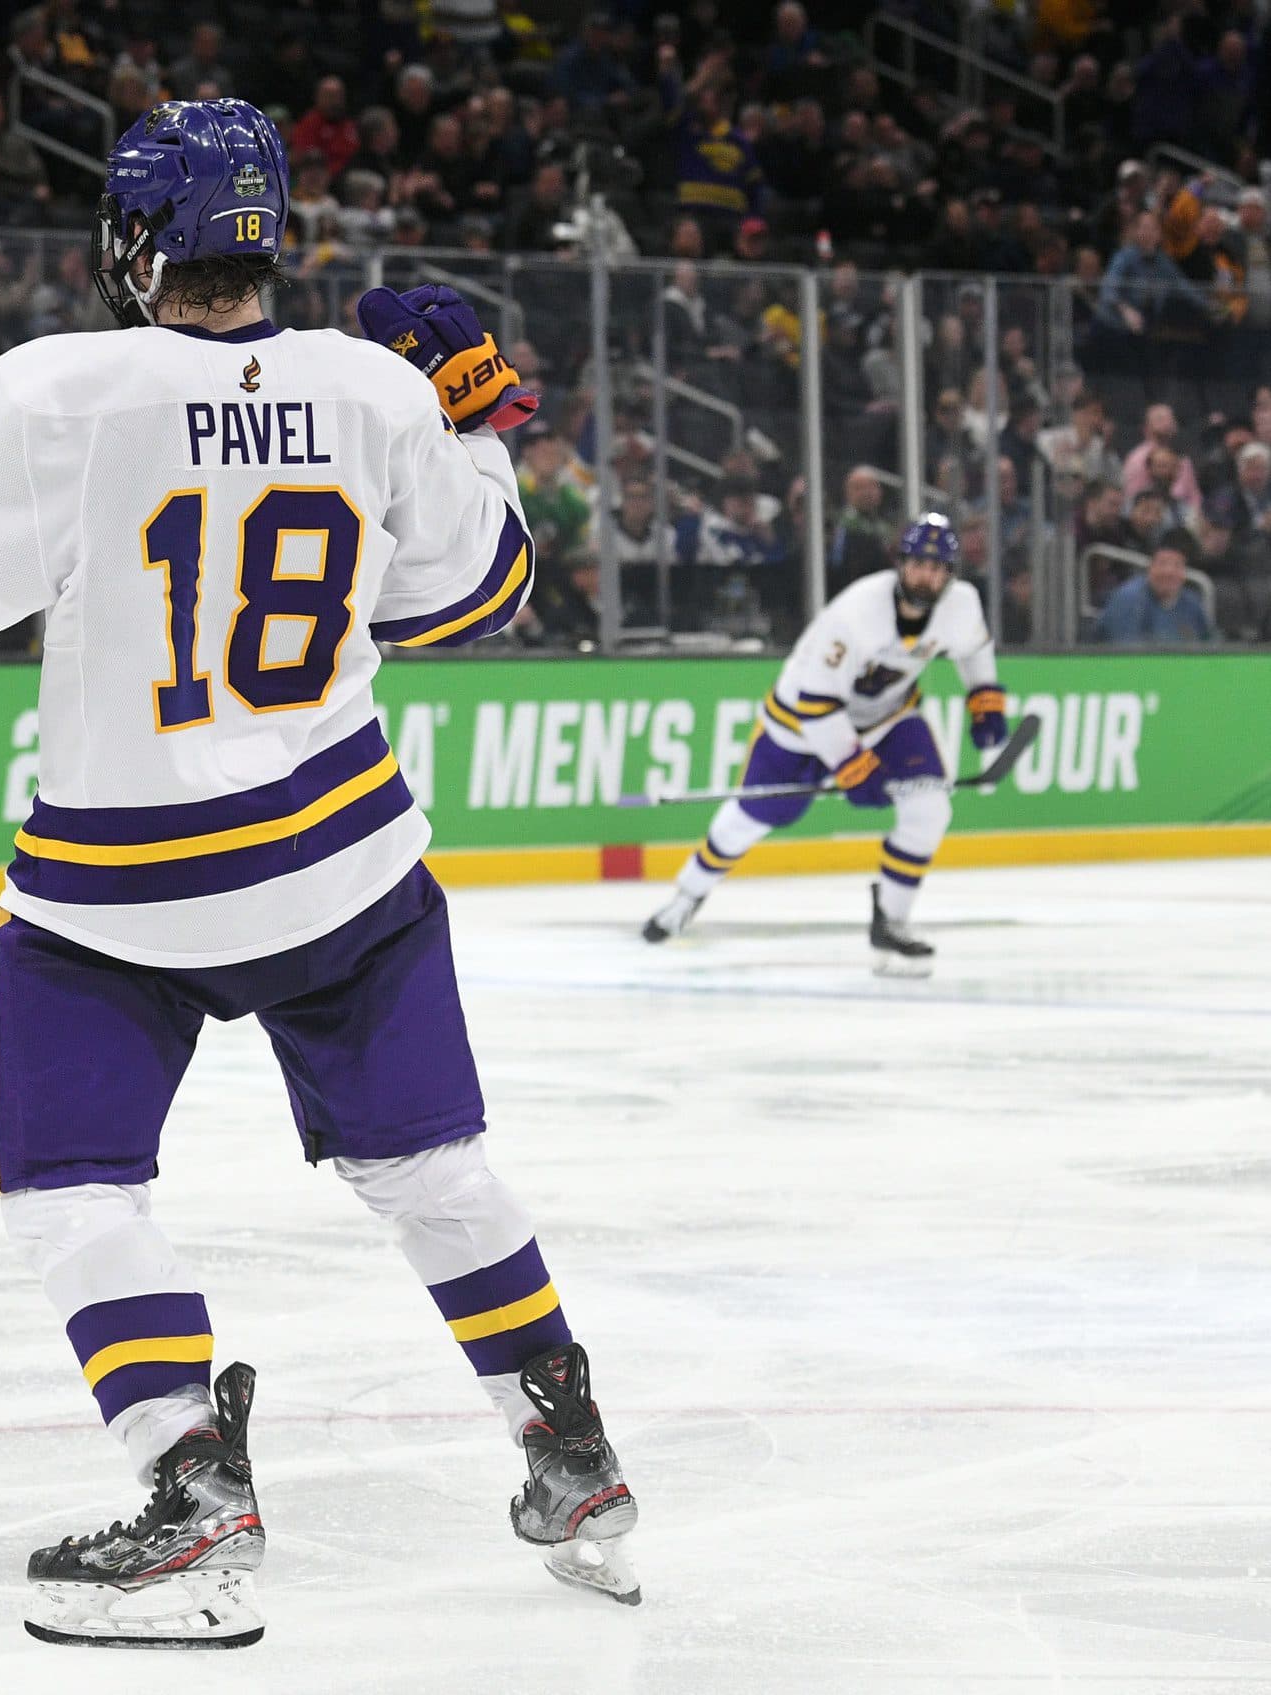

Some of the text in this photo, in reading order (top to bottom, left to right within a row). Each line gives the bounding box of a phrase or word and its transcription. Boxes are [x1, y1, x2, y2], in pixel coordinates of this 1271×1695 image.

[235, 214, 261, 242] 18
[444, 354, 516, 406] UER
[186, 402, 332, 466] PAVEL
[139, 483, 366, 735] 18
[825, 641, 847, 669] 3
[469, 699, 695, 808] MEN'S
[217, 1578, 242, 1592] TUK
